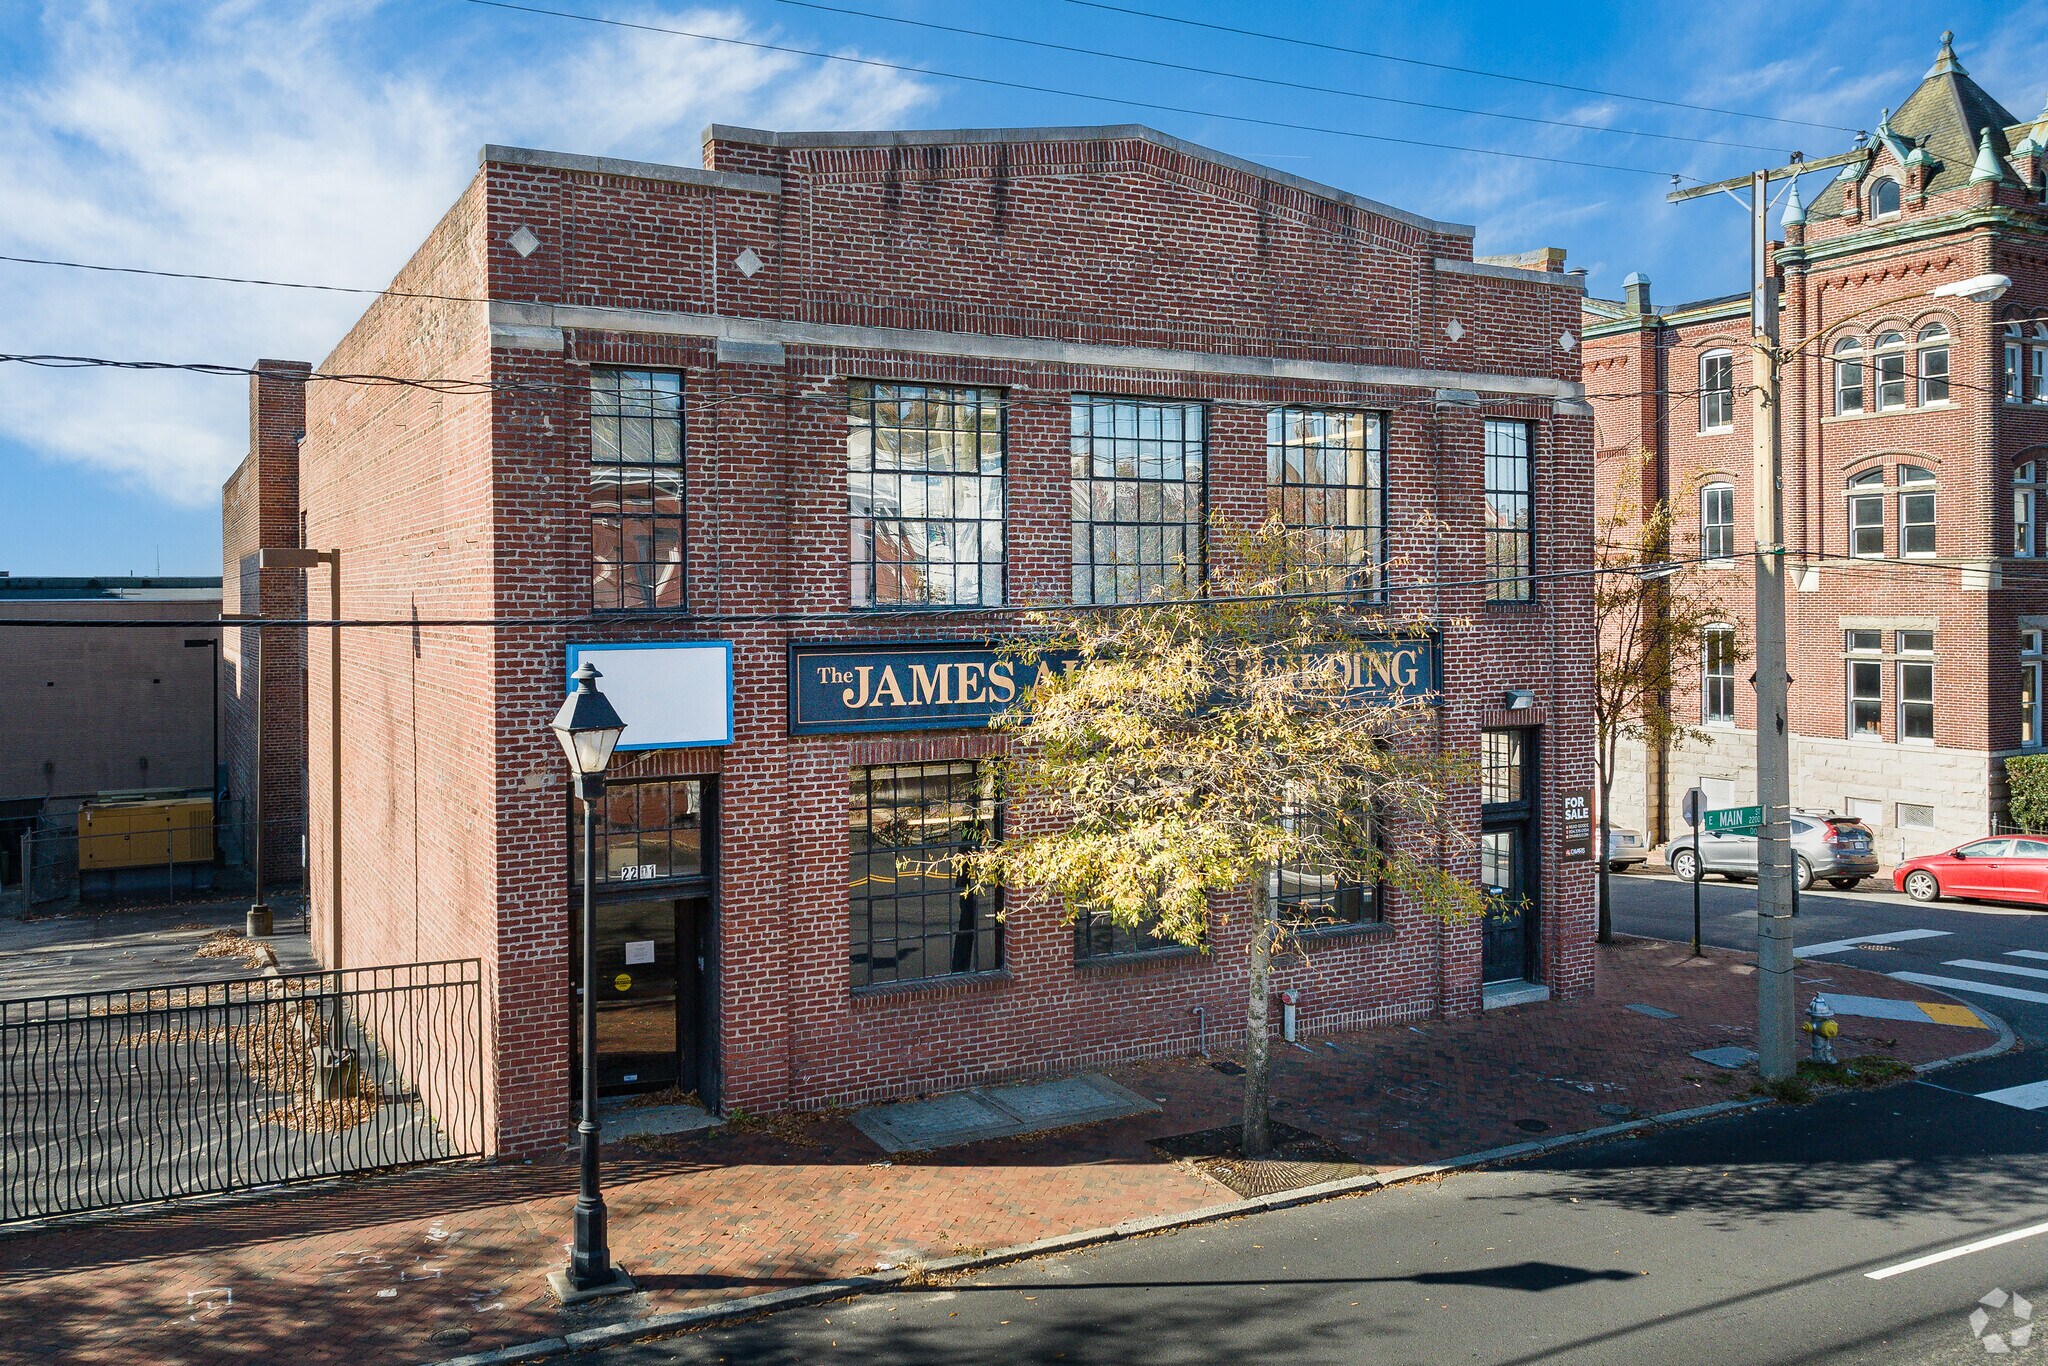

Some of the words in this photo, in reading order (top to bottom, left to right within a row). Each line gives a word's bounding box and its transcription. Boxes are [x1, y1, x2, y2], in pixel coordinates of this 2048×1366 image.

[817, 667, 853, 684] The
[842, 661, 1016, 708] JAMES
[1565, 797, 1584, 808] FOR
[1565, 808, 1589, 820] SALE
[1708, 815, 1713, 825] E
[1719, 809, 1743, 827] MAIN
[1748, 816, 1761, 824] 2200
[622, 866, 655, 880] 2201
